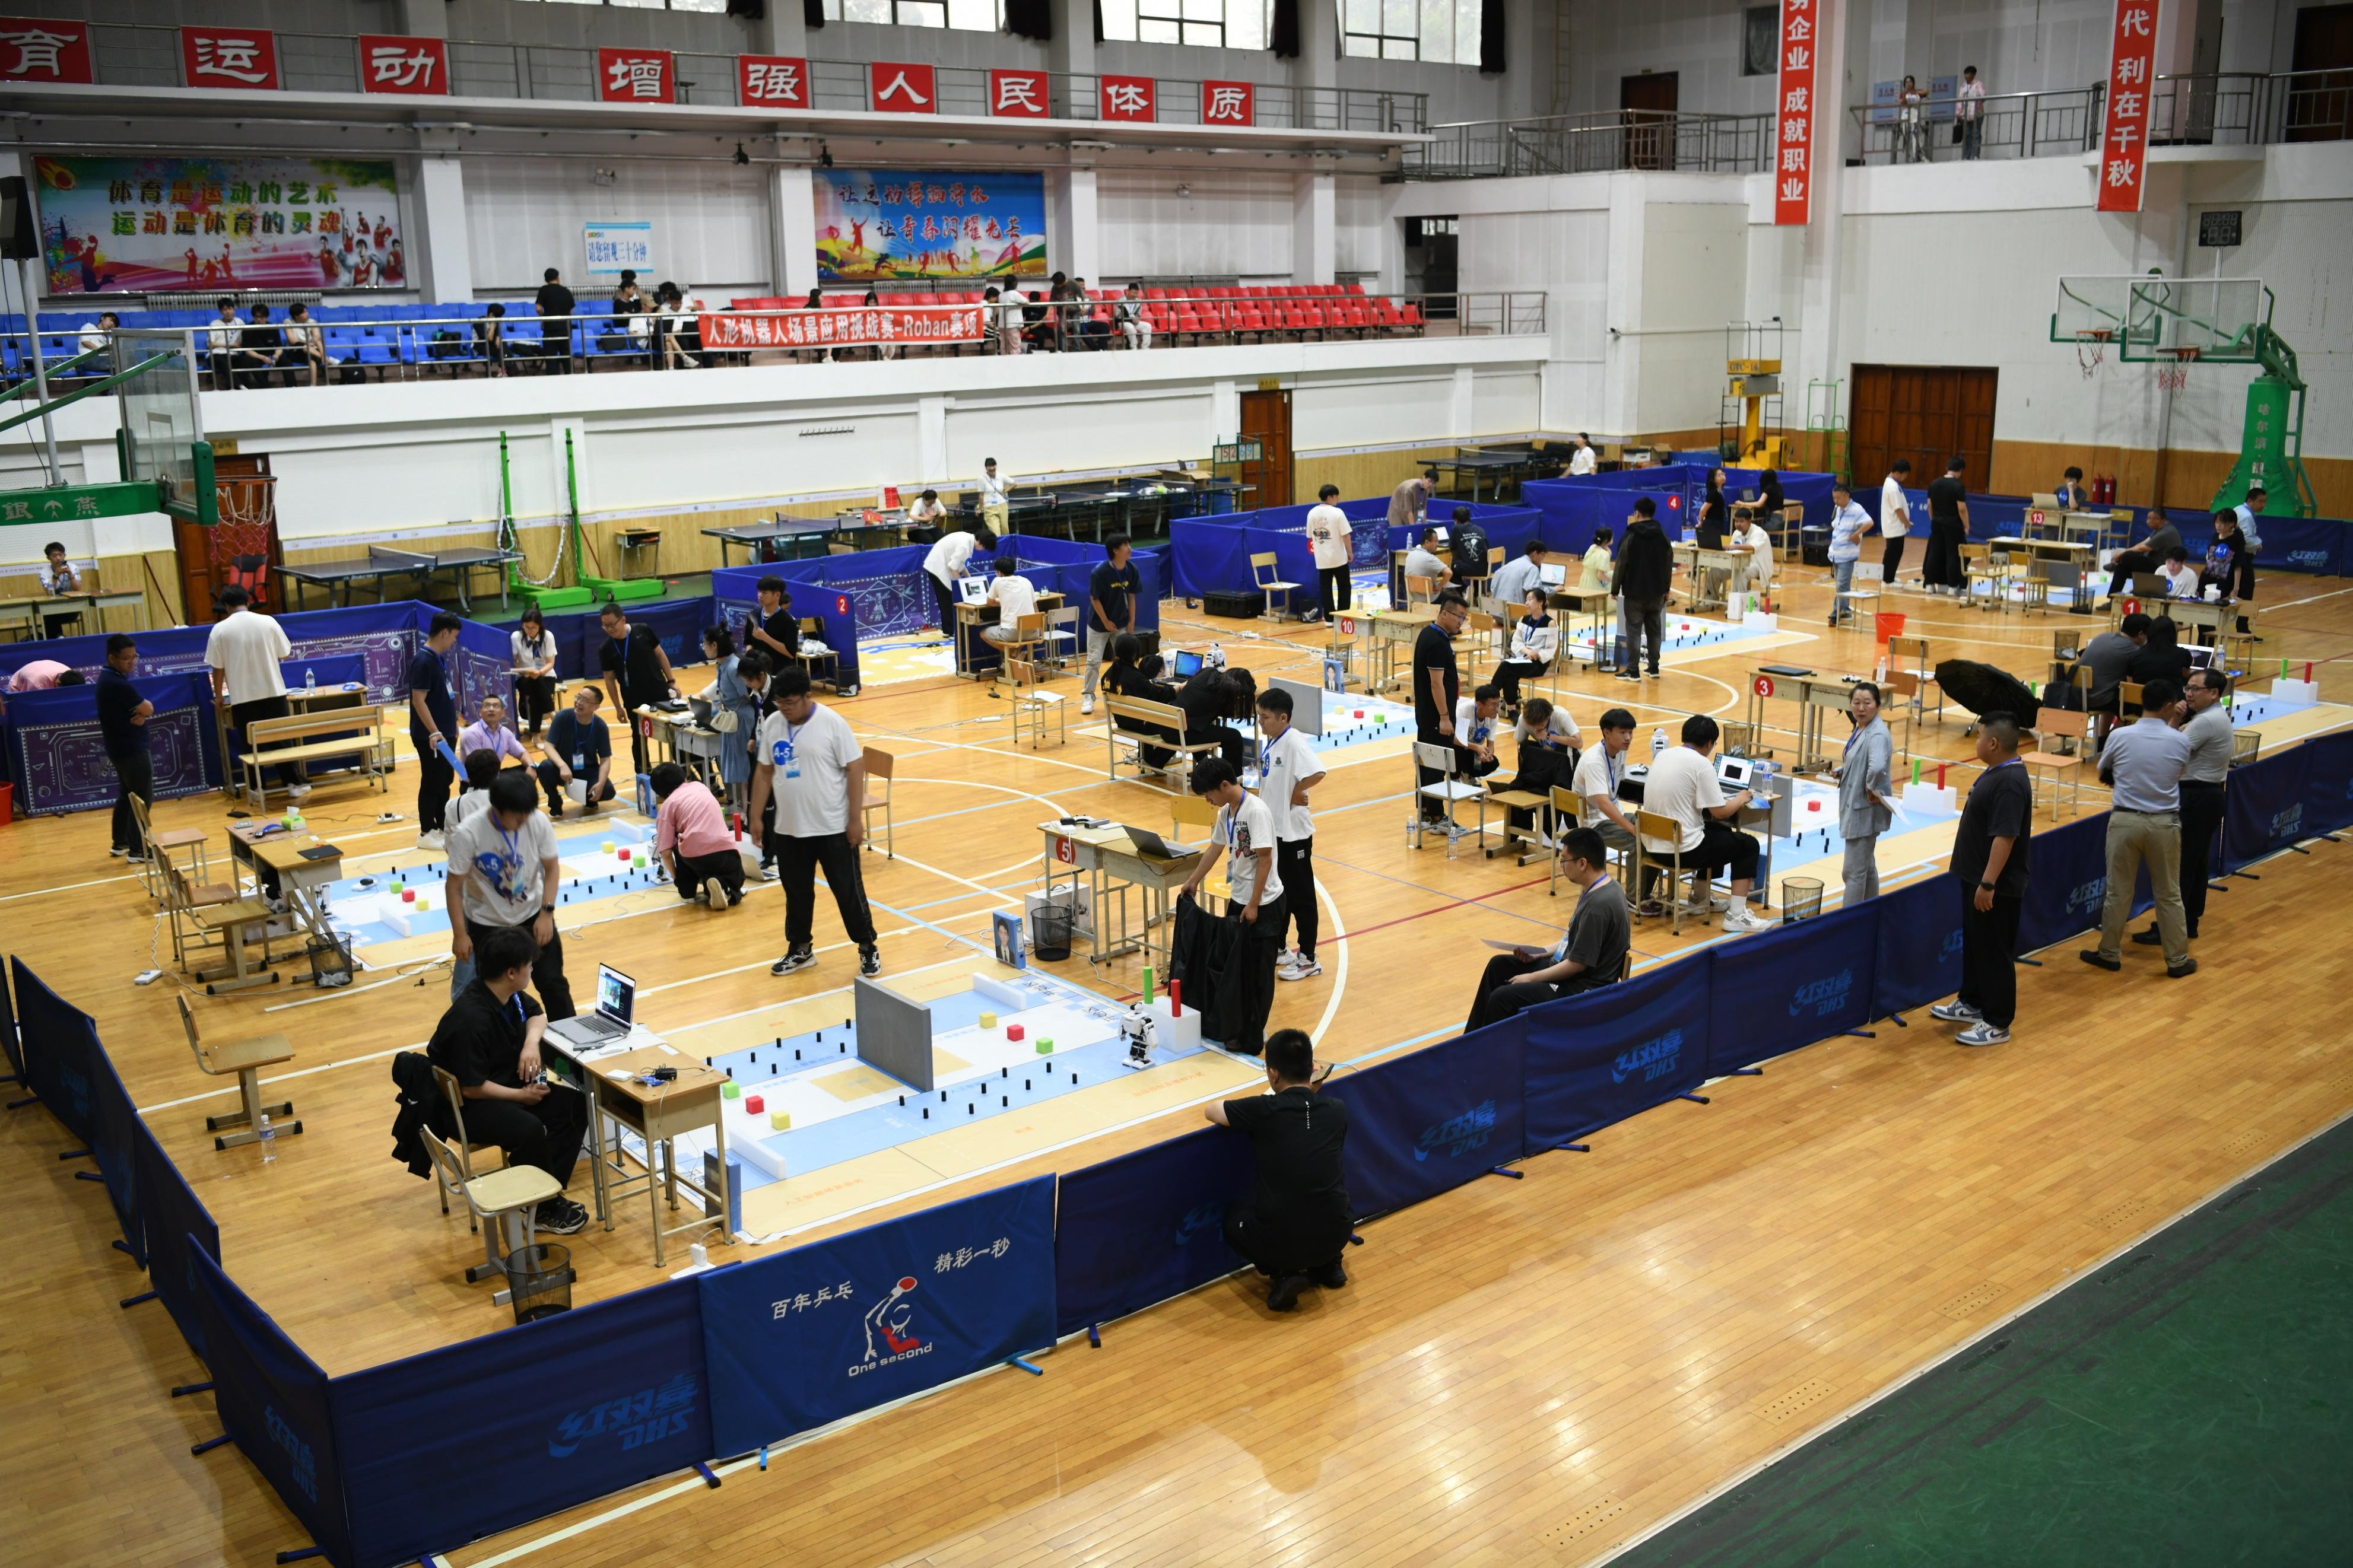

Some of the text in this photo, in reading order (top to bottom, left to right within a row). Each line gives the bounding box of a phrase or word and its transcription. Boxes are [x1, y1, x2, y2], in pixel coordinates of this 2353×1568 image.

[2107, 56, 2145, 187] 利在千秋
[109, 180, 339, 204] 体育是运动的艺术
[838, 181, 990, 208] 让运动挥洒汗水
[111, 210, 342, 235] 运动是体育的灵魂
[877, 215, 1022, 243] 让青春闪耀光芒
[588, 241, 647, 262] 请您留观三十分钟
[1670, 497, 1678, 508] 4
[2033, 513, 2043, 523] 13
[2216, 546, 2227, 556] A-1
[840, 599, 846, 611] 2
[2129, 602, 2135, 613] 1
[1342, 621, 1353, 632] 10
[1760, 679, 1769, 695] 3
[643, 720, 650, 734] 8
[773, 748, 790, 758] A-5
[1060, 841, 1071, 861] 5
[477, 857, 499, 872] A-5
[1795, 969, 1852, 1003] 红双喜
[1817, 991, 1850, 1017] DHS
[1615, 1028, 1684, 1071] 红双喜
[1643, 1052, 1681, 1083] DHS
[1420, 1098, 1497, 1147] 红双喜
[1450, 1127, 1495, 1158] DHS
[933, 1237, 1011, 1274] 精彩一秒
[771, 1280, 853, 1320] 百年乒乓
[848, 1342, 933, 1377] One second
[557, 1373, 699, 1440] 红双喜
[617, 1406, 697, 1451] DHS
